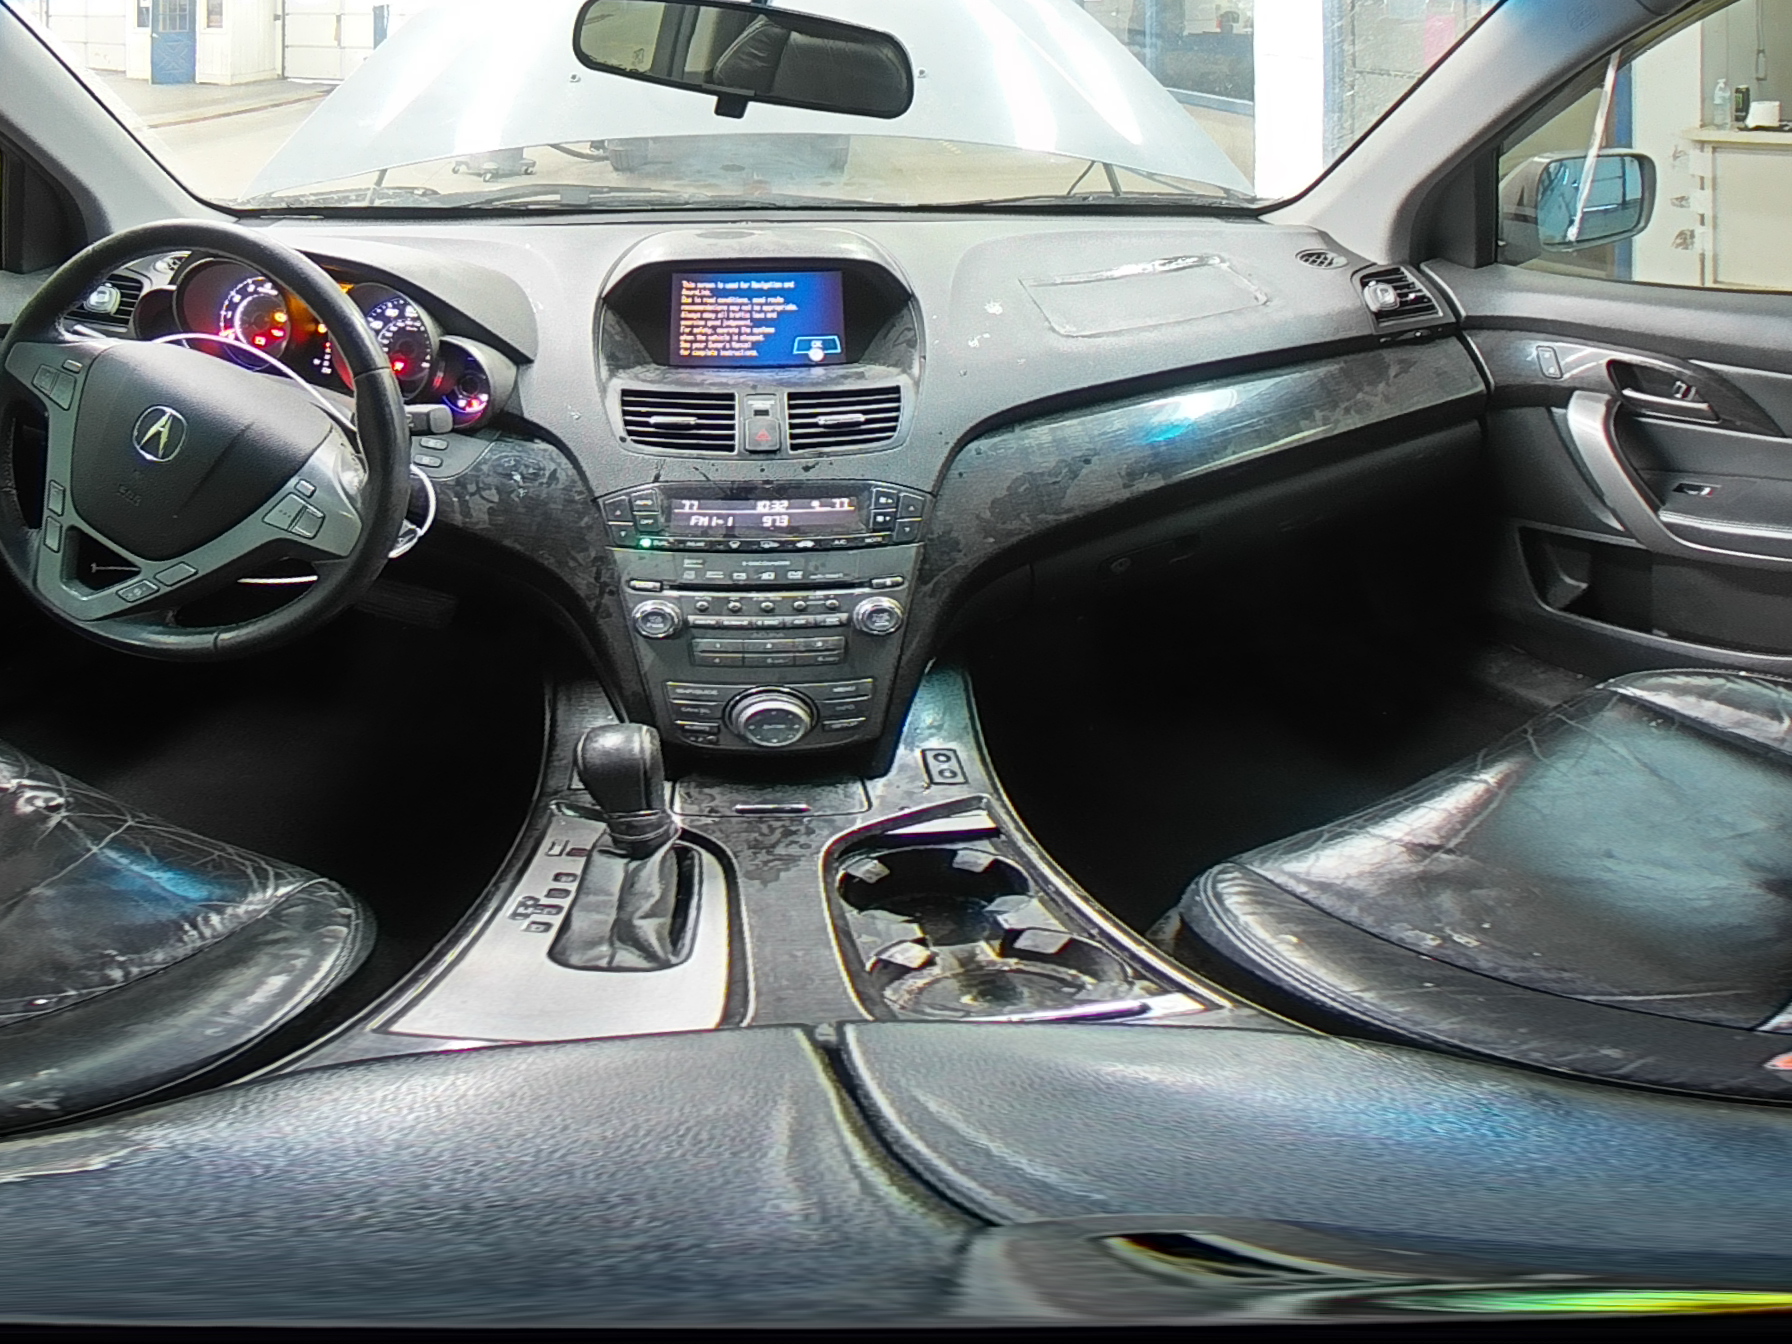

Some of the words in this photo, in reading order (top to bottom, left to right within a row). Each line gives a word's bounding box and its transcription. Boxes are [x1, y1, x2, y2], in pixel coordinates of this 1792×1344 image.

[811, 340, 823, 348] OK
[682, 500, 698, 511] 77
[831, 498, 850, 509] 77
